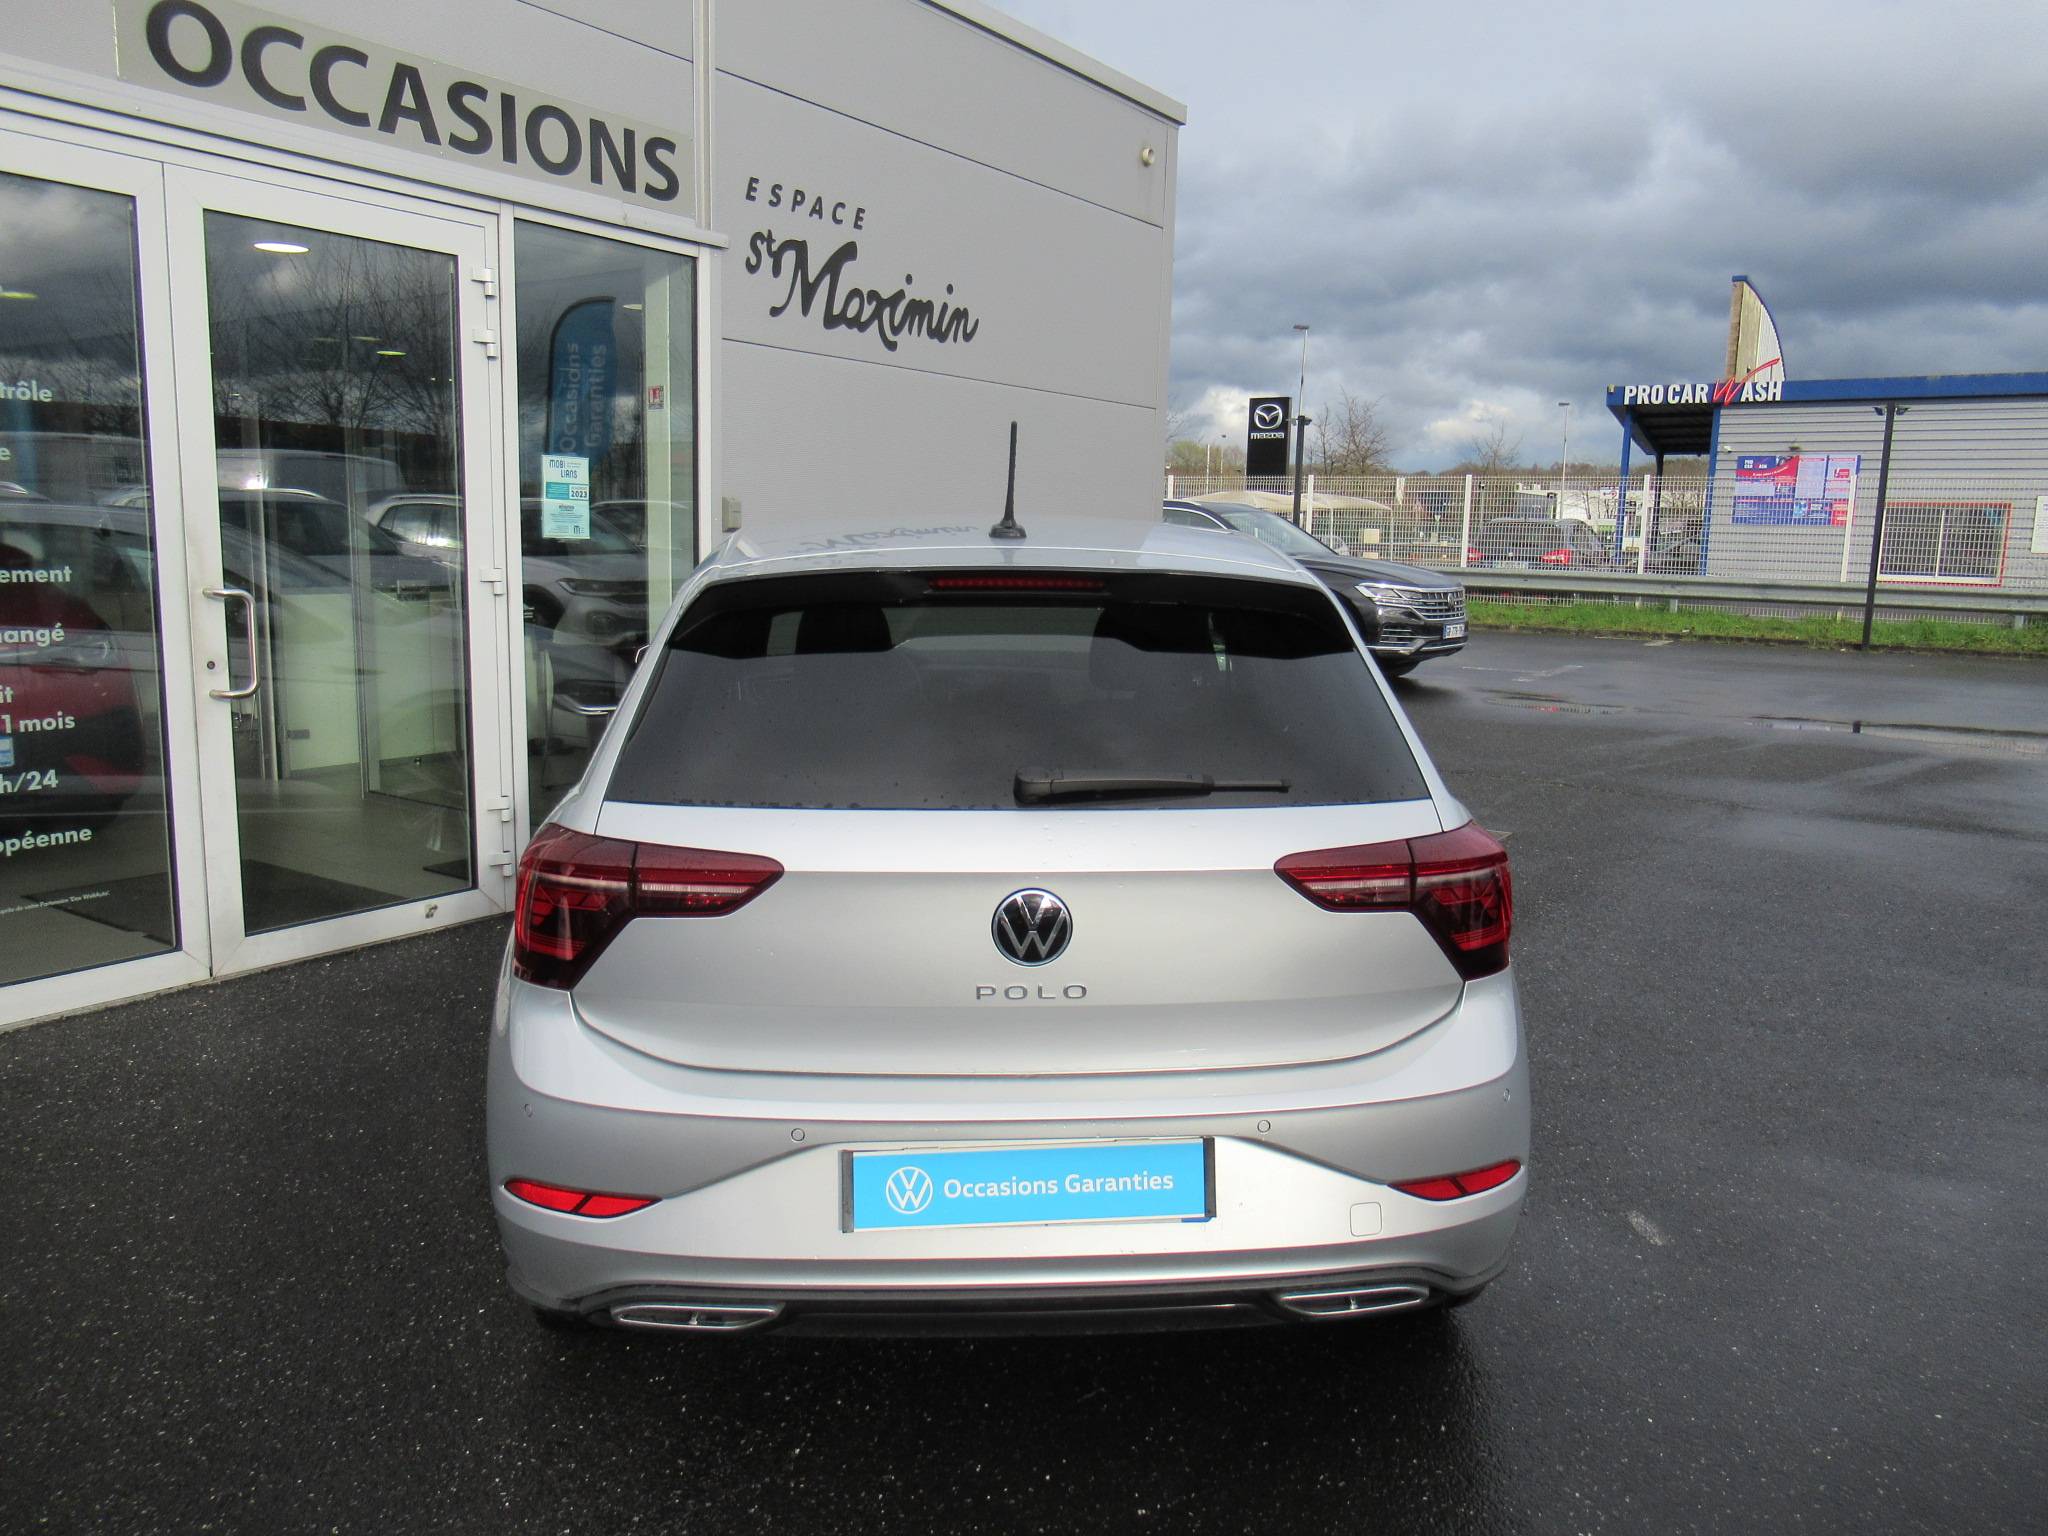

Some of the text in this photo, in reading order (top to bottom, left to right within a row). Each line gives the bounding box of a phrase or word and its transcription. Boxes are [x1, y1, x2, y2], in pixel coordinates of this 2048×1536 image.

[145, 0, 680, 202] OCCASIONS
[746, 176, 866, 230] ESPACE
[745, 229, 979, 352] St Maximin
[1623, 358, 1783, 406] PRO CAR WASH
[571, 490, 588, 498] 2023
[0, 565, 72, 583] ement
[0, 622, 65, 647] angé
[19, 710, 76, 733] mois
[976, 984, 1087, 1000] POLO
[943, 1175, 1058, 1198] Occasions
[1064, 1170, 1174, 1193] Garanties
